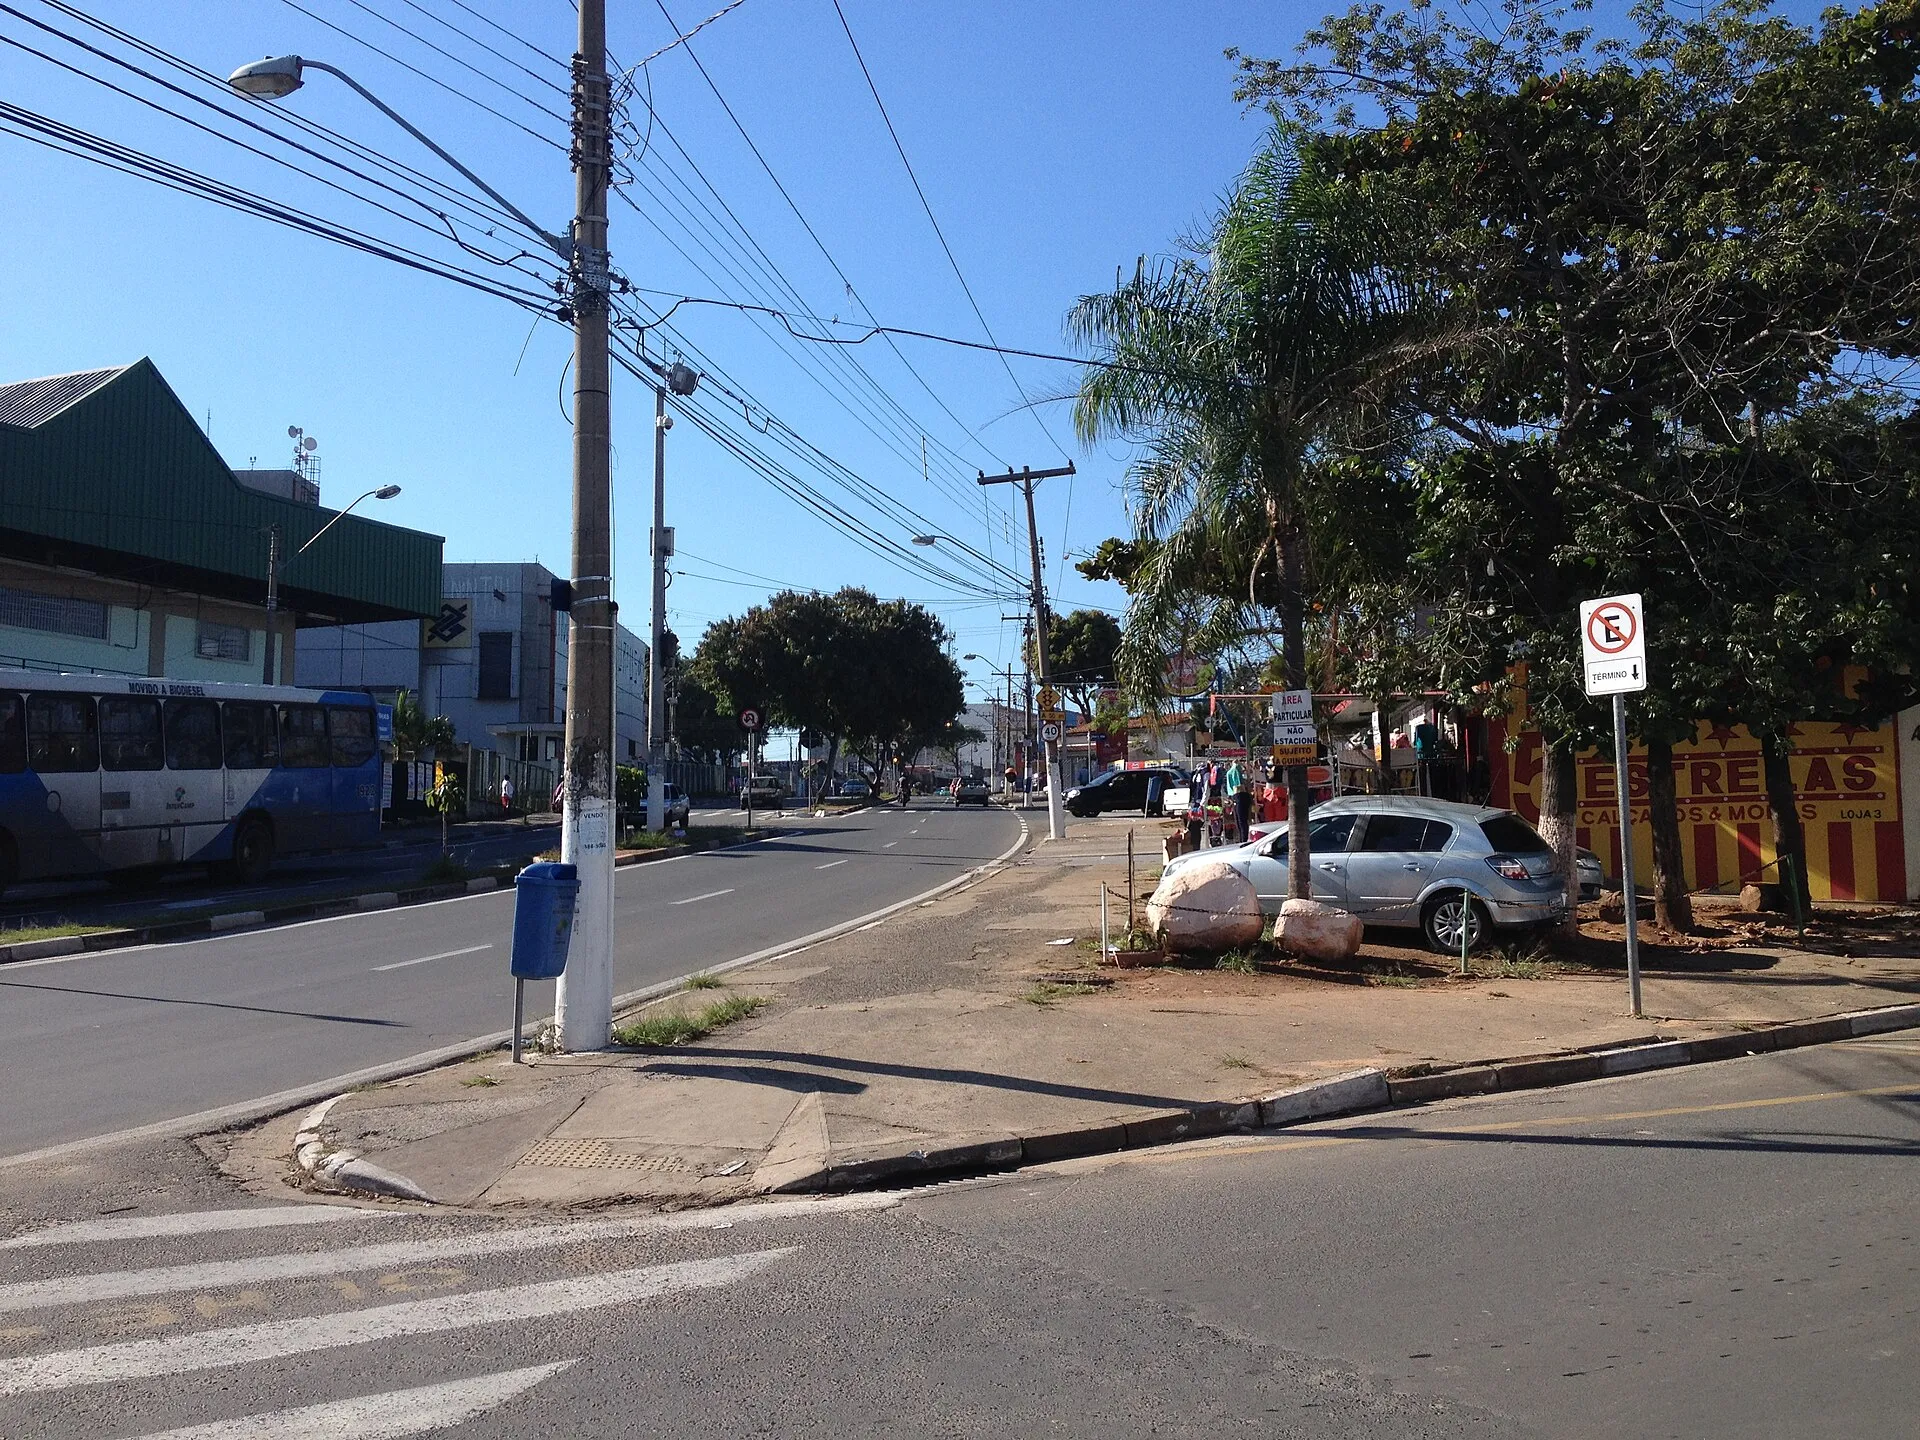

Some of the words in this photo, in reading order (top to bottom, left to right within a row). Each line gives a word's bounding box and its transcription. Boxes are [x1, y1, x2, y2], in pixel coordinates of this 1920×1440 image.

[1604, 615, 1621, 643] E
[1592, 671, 1628, 681] TÉRMINO
[128, 682, 159, 694] MOVIDO
[161, 684, 168, 695] A
[169, 684, 206, 696] BIODIESEL
[1273, 710, 1312, 721] PARTICULAR
[1044, 726, 1058, 736] 40
[1274, 737, 1317, 745] ESTACIONE
[1280, 747, 1312, 755] SUJEITO
[1709, 805, 1722, 822] &
[1841, 809, 1871, 819] LOJA
[1873, 809, 1882, 819] 3
